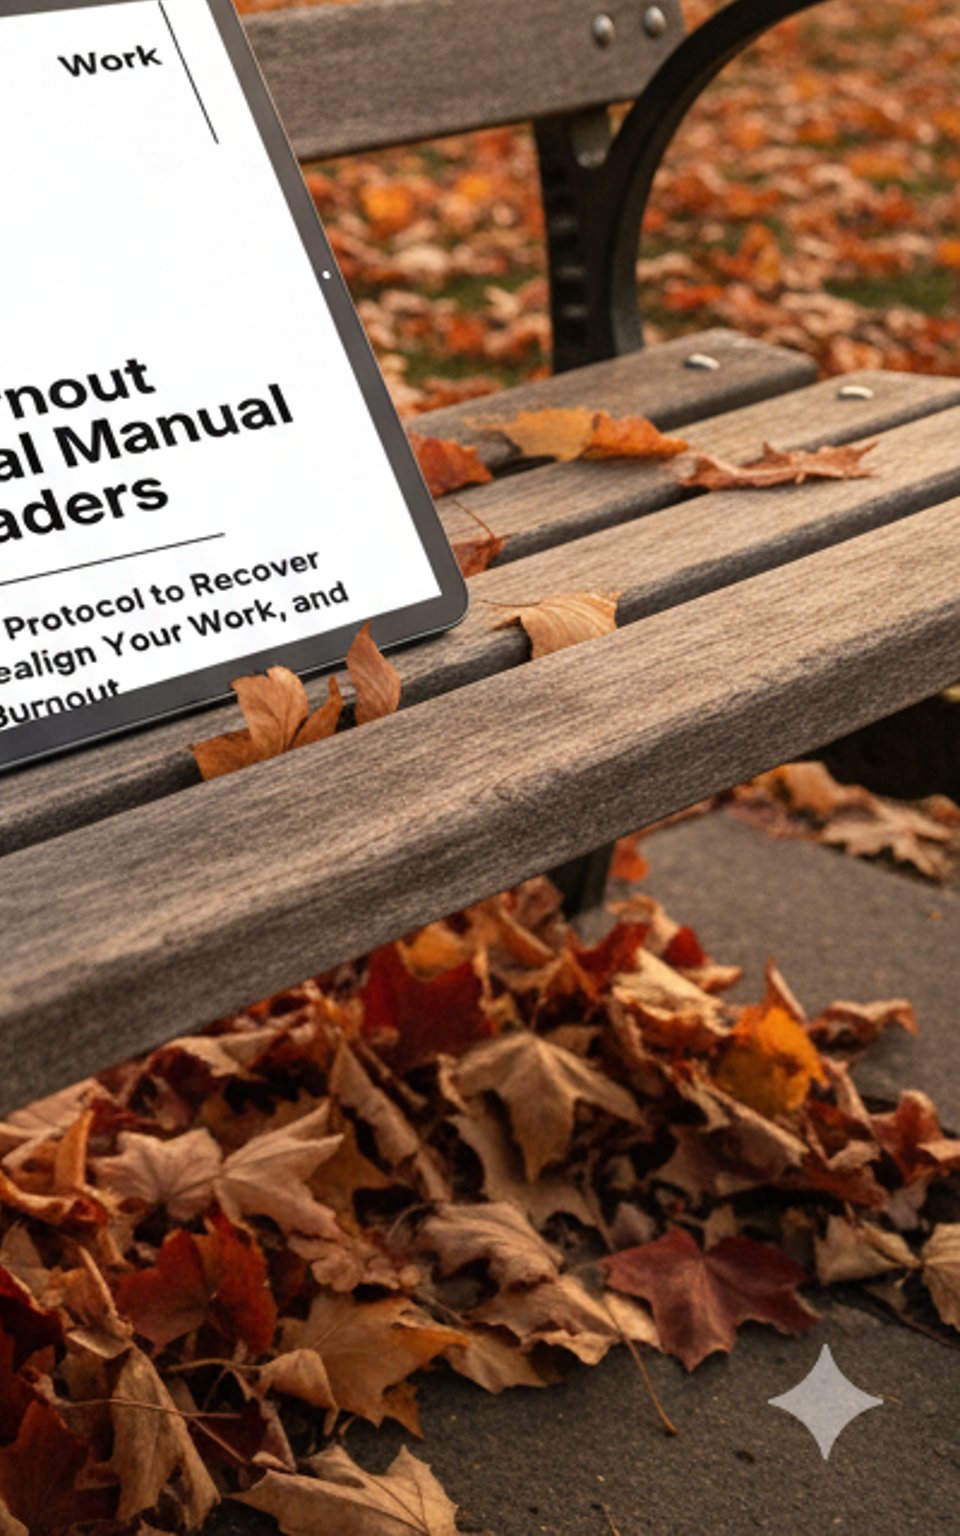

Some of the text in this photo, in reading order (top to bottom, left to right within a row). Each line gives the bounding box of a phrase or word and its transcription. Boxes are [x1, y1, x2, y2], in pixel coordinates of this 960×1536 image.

[58, 44, 162, 77] Work
[52, 382, 294, 468] Manual
[3, 586, 146, 640] Protocol
[150, 584, 185, 606] to
[189, 551, 320, 597] Recover
[101, 624, 182, 656] Your
[187, 598, 288, 636] Work,
[292, 580, 350, 614] and
